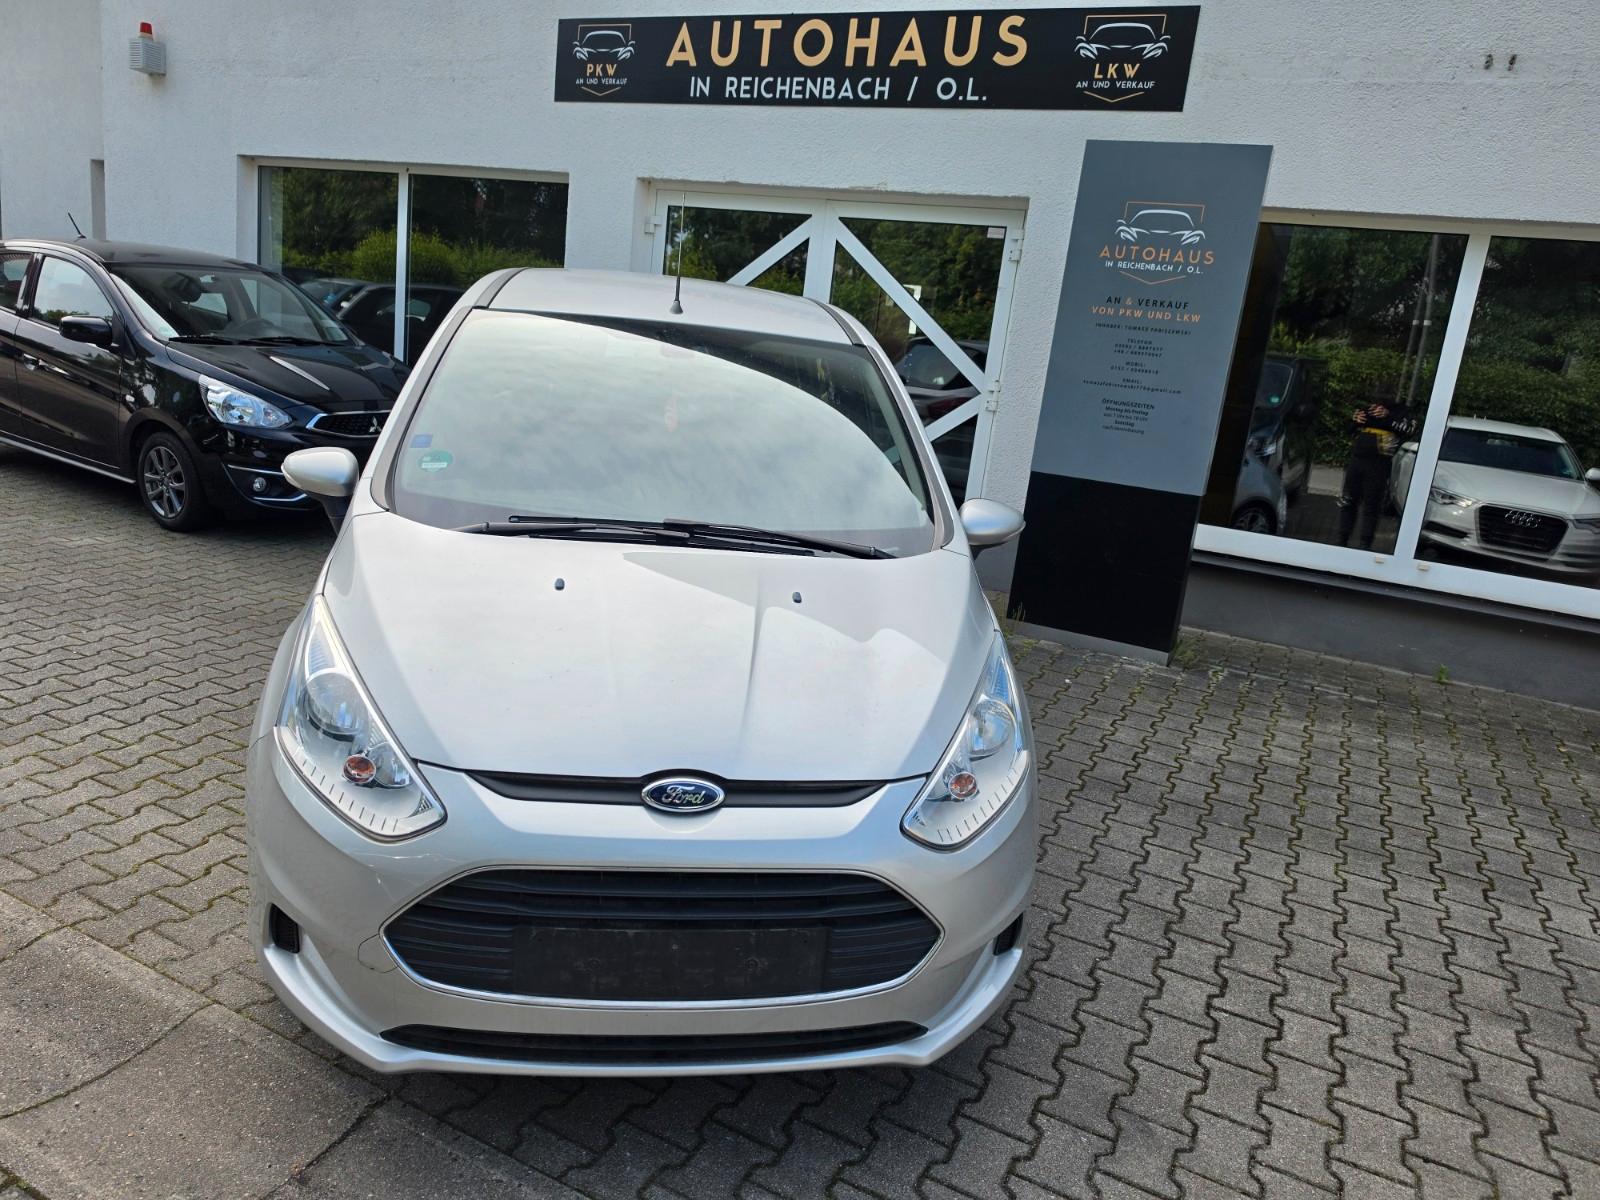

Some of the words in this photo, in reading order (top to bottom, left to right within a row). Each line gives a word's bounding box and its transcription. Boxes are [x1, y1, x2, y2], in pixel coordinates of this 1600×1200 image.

[666, 15, 1028, 67] AUTOHAUS
[586, 63, 617, 76] PKW
[1094, 63, 1140, 79] LKW
[601, 77, 628, 85] VERKAUF
[690, 76, 710, 97] IN
[725, 76, 890, 100] REICHENBACH
[906, 76, 919, 101] /
[936, 77, 987, 101] O.L.
[1076, 80, 1088, 89] AN
[1093, 80, 1110, 89] UND
[1115, 80, 1155, 89] VERKAUF
[1099, 245, 1215, 265] AUTOHAUS
[1117, 261, 1174, 272] REICHENBACH
[1187, 265, 1203, 274] O.L.
[1106, 296, 1121, 305] AN
[1125, 297, 1132, 305] &
[1137, 298, 1190, 310] VERKAUF
[1091, 306, 1114, 316] VON
[1118, 308, 1143, 318] PKW
[1147, 310, 1172, 320] UND
[1176, 312, 1201, 323] LKW
[661, 784, 707, 804] Ford
